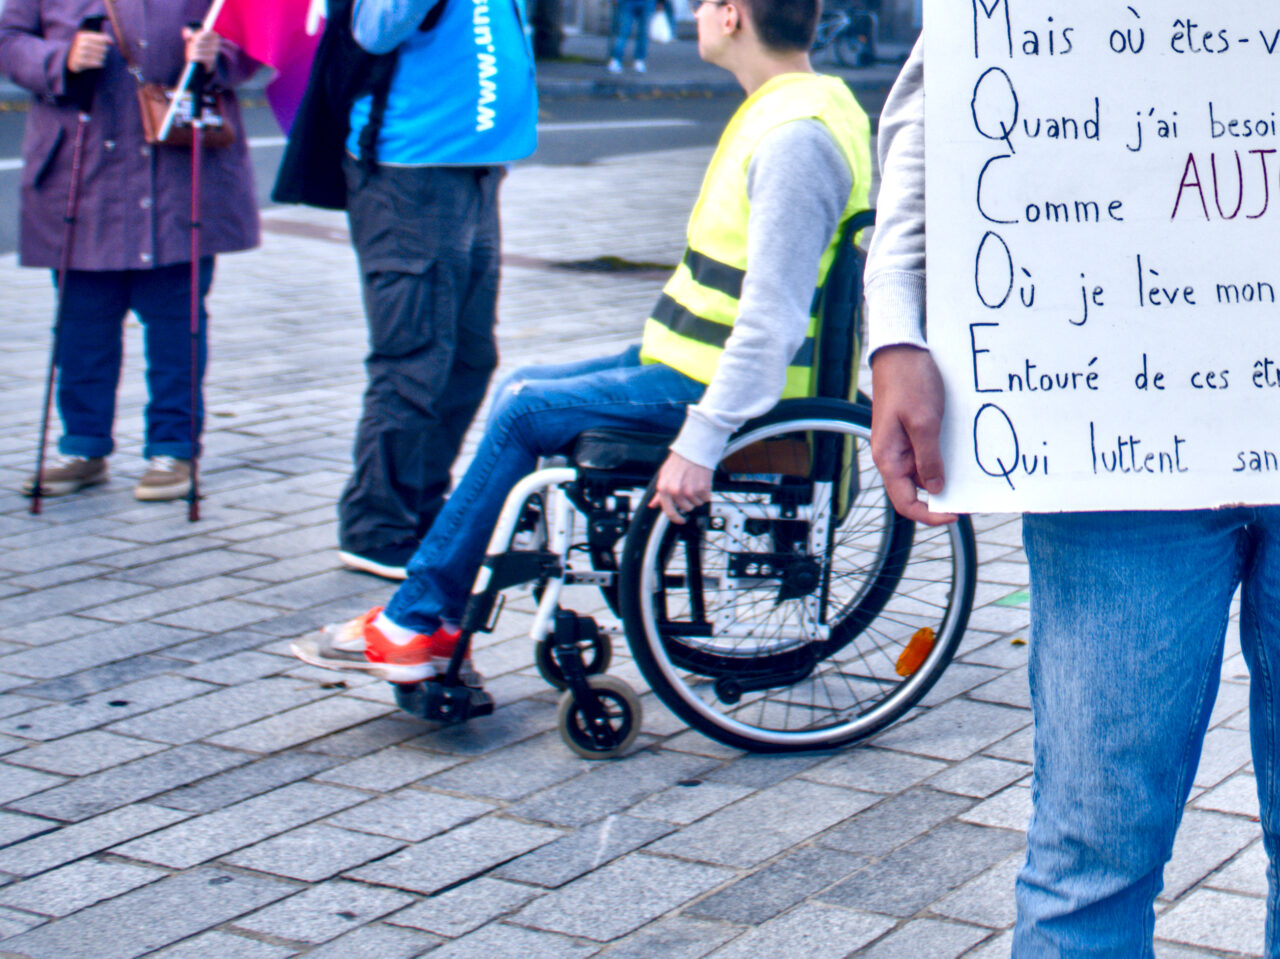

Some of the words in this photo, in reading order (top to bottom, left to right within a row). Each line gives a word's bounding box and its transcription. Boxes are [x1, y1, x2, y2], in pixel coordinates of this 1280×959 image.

[1109, 6, 1145, 55] où
[970, 66, 1100, 155] Quand
[1126, 106, 1178, 153] j'ai
[976, 153, 1125, 225] Comme
[974, 229, 1036, 310] Où
[1068, 272, 1105, 327] je
[1136, 253, 1197, 308] lève
[1215, 281, 1276, 305] mon
[968, 321, 1099, 394] Entouré
[1134, 352, 1166, 392] de
[1190, 368, 1230, 390] ces
[972, 402, 1049, 491] Qui
[1089, 420, 1190, 475] luttent
